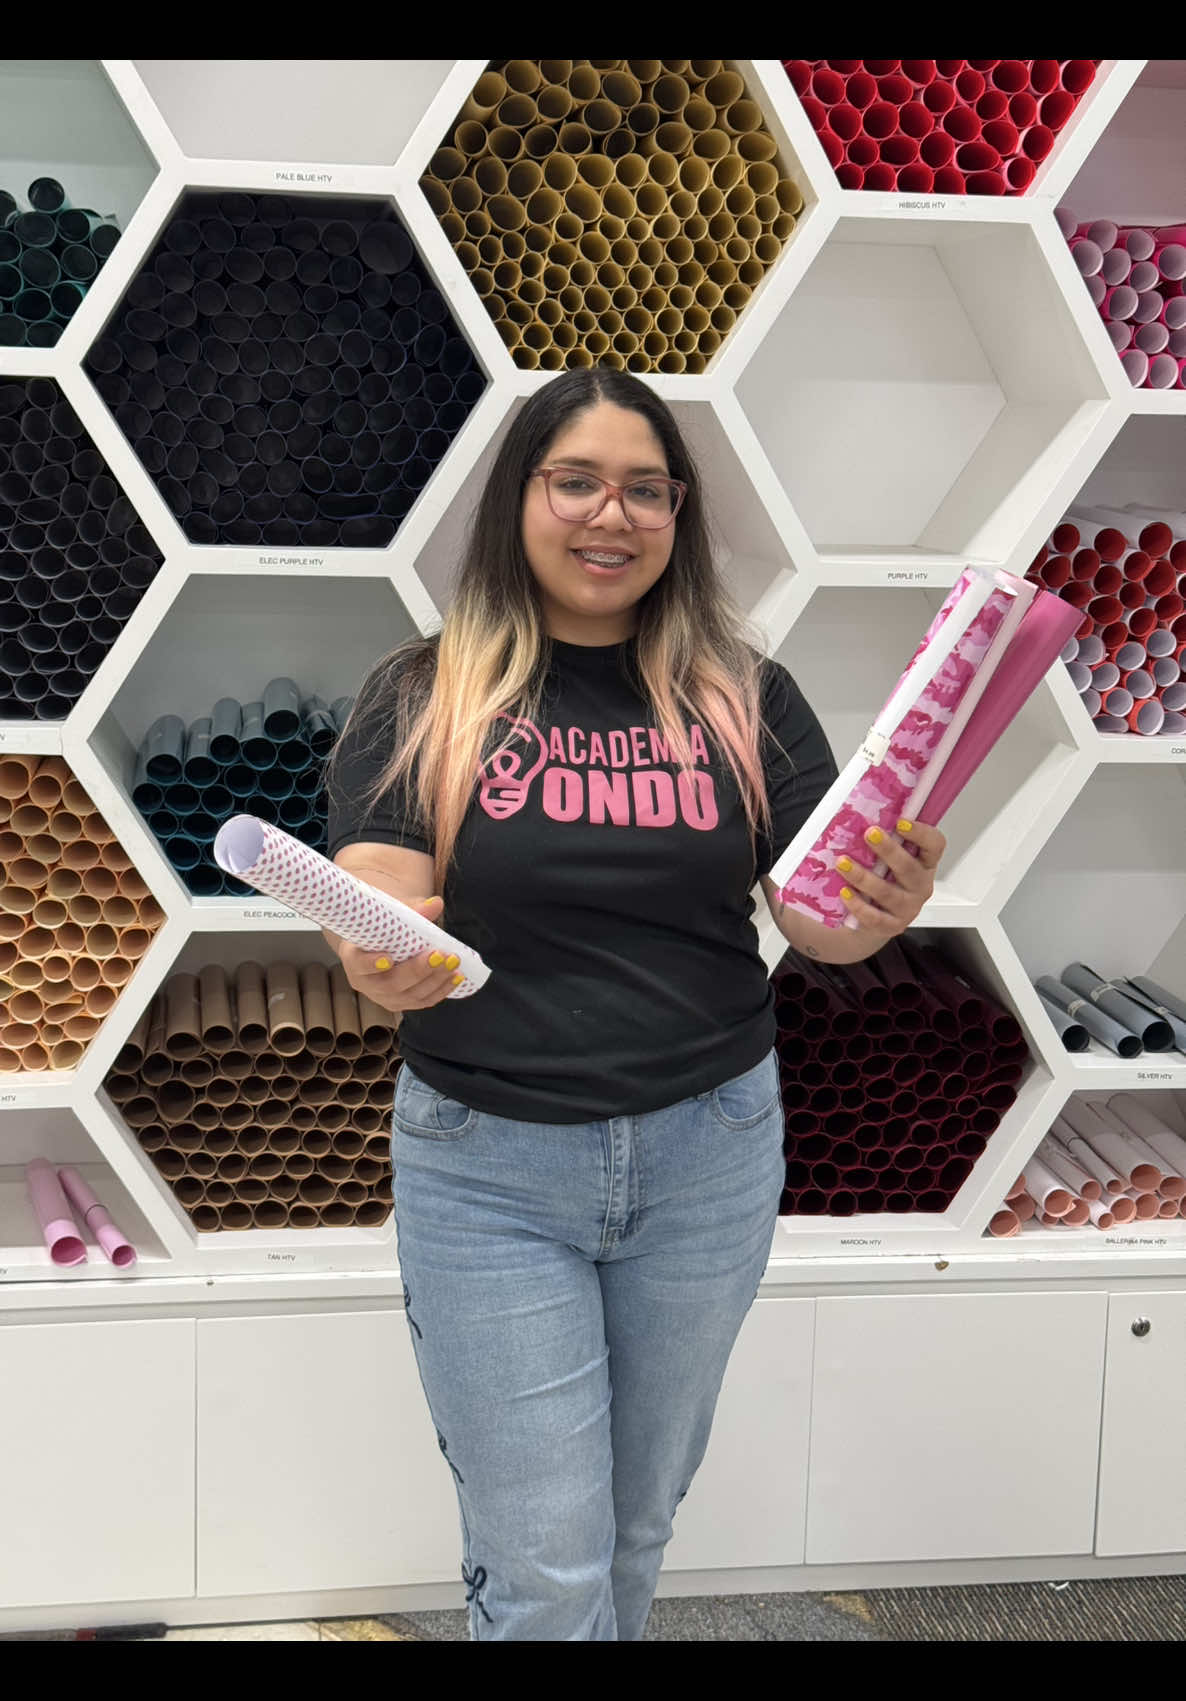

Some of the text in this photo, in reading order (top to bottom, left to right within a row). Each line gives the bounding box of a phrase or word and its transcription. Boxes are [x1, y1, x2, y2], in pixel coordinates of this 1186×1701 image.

[275, 172, 333, 183] PALE BLUE HTV
[898, 201, 946, 209] HIBISCUS HTV
[259, 557, 324, 567] ELEC PURPLE HTV
[887, 572, 929, 580] PURPLE HTV
[549, 724, 710, 768] ACADEMA
[542, 767, 719, 832] ONDO
[263, 911, 298, 919] PEACOCK
[1136, 1072, 1174, 1081] SILVER HTV
[869, 1239, 882, 1247] HTV
[267, 1253, 297, 1262] TAN HTV
